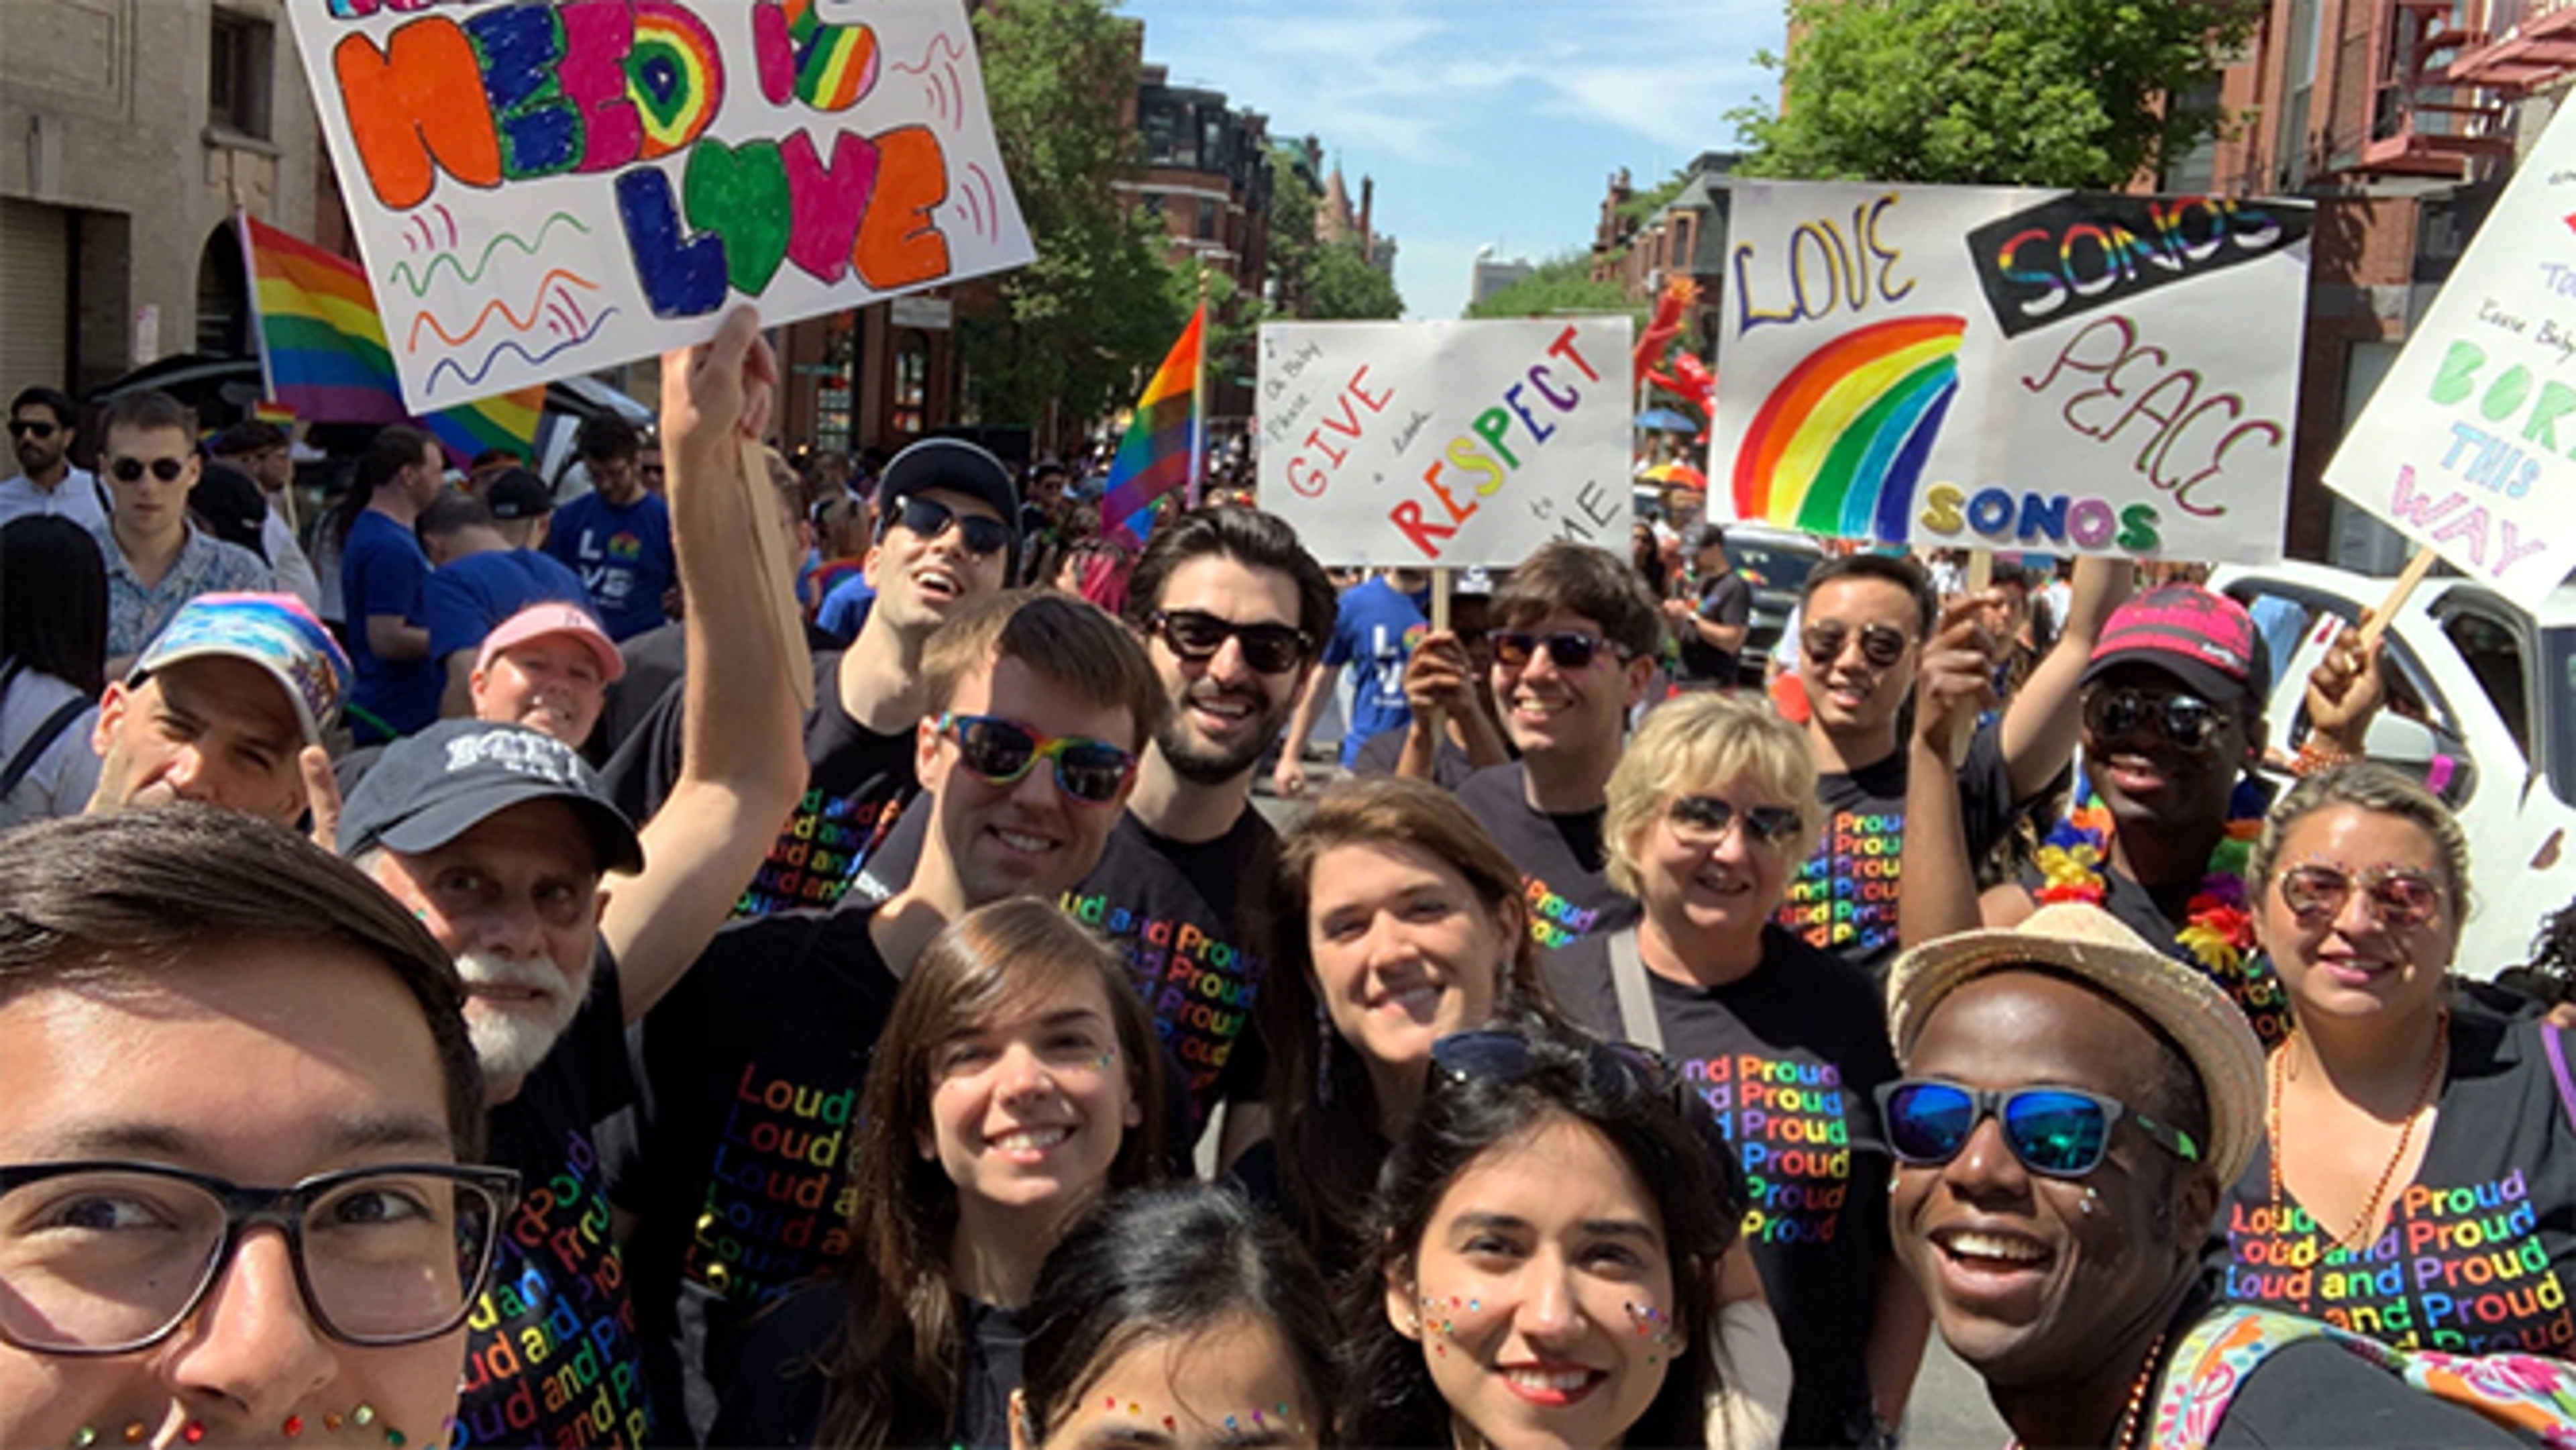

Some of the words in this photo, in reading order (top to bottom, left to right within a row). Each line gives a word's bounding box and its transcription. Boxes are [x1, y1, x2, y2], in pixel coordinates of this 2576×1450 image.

[333, 0, 725, 209] NEED
[753, 0, 879, 111] IS
[614, 125, 949, 319] LOVE
[1733, 191, 1915, 339] LOVE
[1997, 195, 2282, 317] SONOS
[1287, 364, 1395, 499] GIVE
[2021, 314, 2284, 517] PEACE
[2428, 340, 2576, 462] BOR
[1388, 325, 1599, 559] RESPECT
[2440, 421, 2540, 499] THIS
[1551, 480, 1622, 543] ME
[1919, 484, 2161, 552] SONOS
[2390, 464, 2546, 578] WAY
[1835, 811, 1905, 833] Prou
[1835, 835, 1901, 855] Prou
[1834, 876, 1900, 900] Prou
[1835, 856, 1901, 878] Prou
[1525, 880, 1599, 932] Proud
[1834, 900, 1900, 922] Prou
[1168, 953, 1258, 1006] Proud
[1176, 923, 1267, 984] Proud
[1157, 986, 1246, 1037] Proud
[737, 1061, 854, 1125] Loud
[1684, 1055, 1731, 1082] nd
[1738, 1053, 1841, 1087] Proud
[1740, 1082, 1843, 1116] Proud
[722, 1101, 843, 1168] Loud
[1741, 1110, 1849, 1145] Proud
[712, 1142, 831, 1210] Loud
[1741, 1142, 1851, 1178] Proud
[703, 1179, 817, 1248] Loud
[1746, 1176, 1847, 1209] Proud
[2403, 1169, 2527, 1220] Proud
[1741, 1210, 1839, 1244] Proud
[2226, 1229, 2316, 1267] Loud
[2406, 1201, 2537, 1255] Proud
[2225, 1265, 2313, 1300] Loud
[2320, 1261, 2405, 1300] and
[2414, 1235, 2550, 1290] Proud
[2324, 1296, 2412, 1331] and
[2420, 1270, 2566, 1329] Proud
[541, 1336, 600, 1412] and
